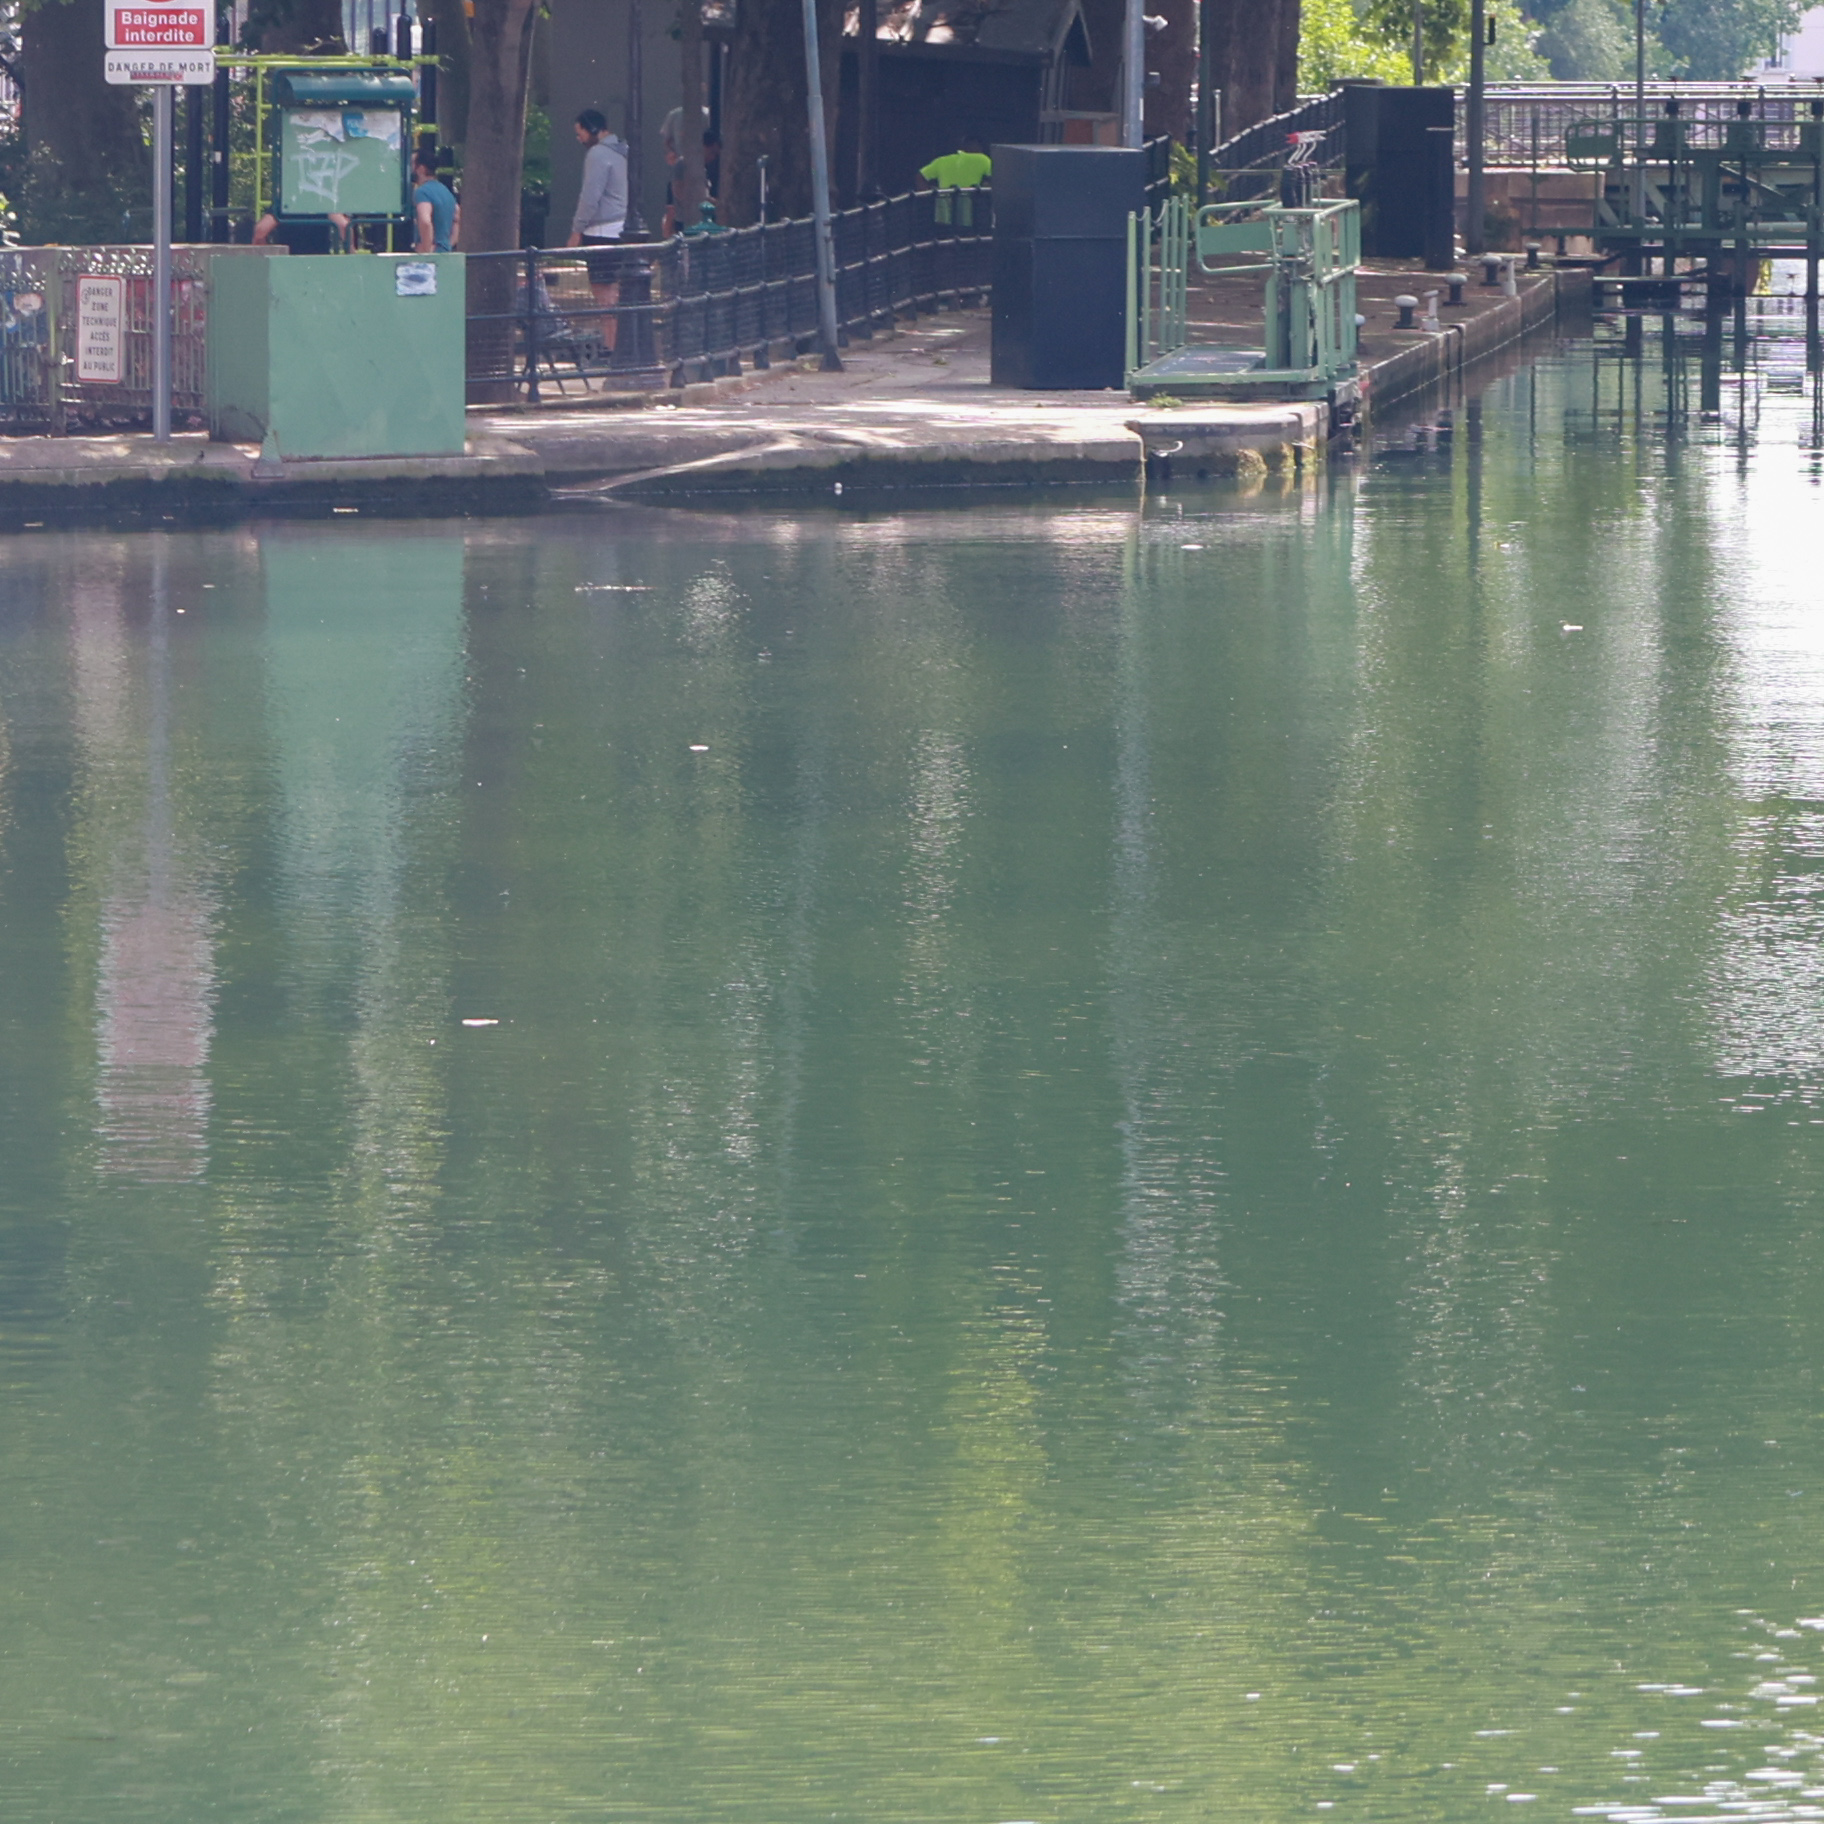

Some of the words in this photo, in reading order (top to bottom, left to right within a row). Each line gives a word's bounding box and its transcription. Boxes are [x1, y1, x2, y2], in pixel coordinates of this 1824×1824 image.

[121, 11, 198, 27] Baignade
[125, 28, 194, 42] interdite
[108, 62, 155, 72] DANGER
[179, 62, 211, 72] MORT
